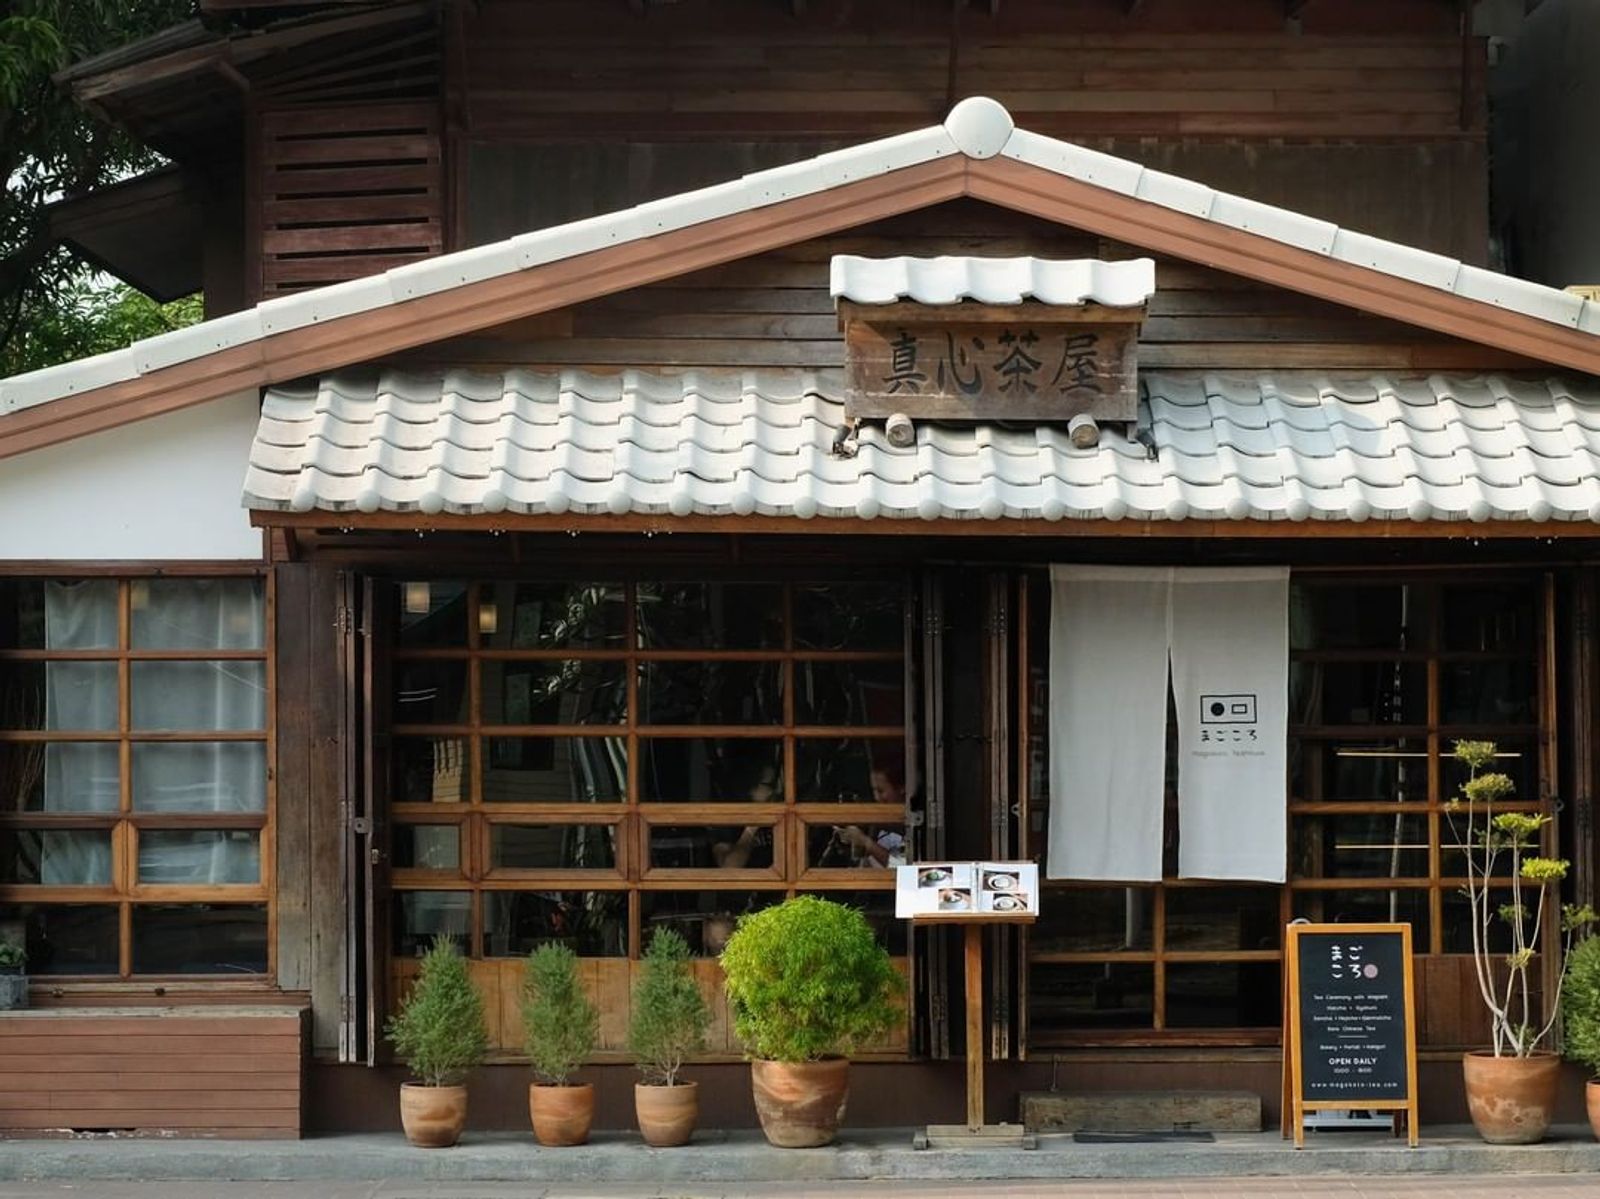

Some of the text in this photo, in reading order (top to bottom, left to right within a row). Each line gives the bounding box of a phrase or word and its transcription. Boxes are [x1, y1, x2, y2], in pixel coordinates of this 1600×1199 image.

[882, 329, 1104, 395] 真心茶屋
[1201, 729, 1258, 742] まごころ
[1353, 1057, 1378, 1065] DAILY
